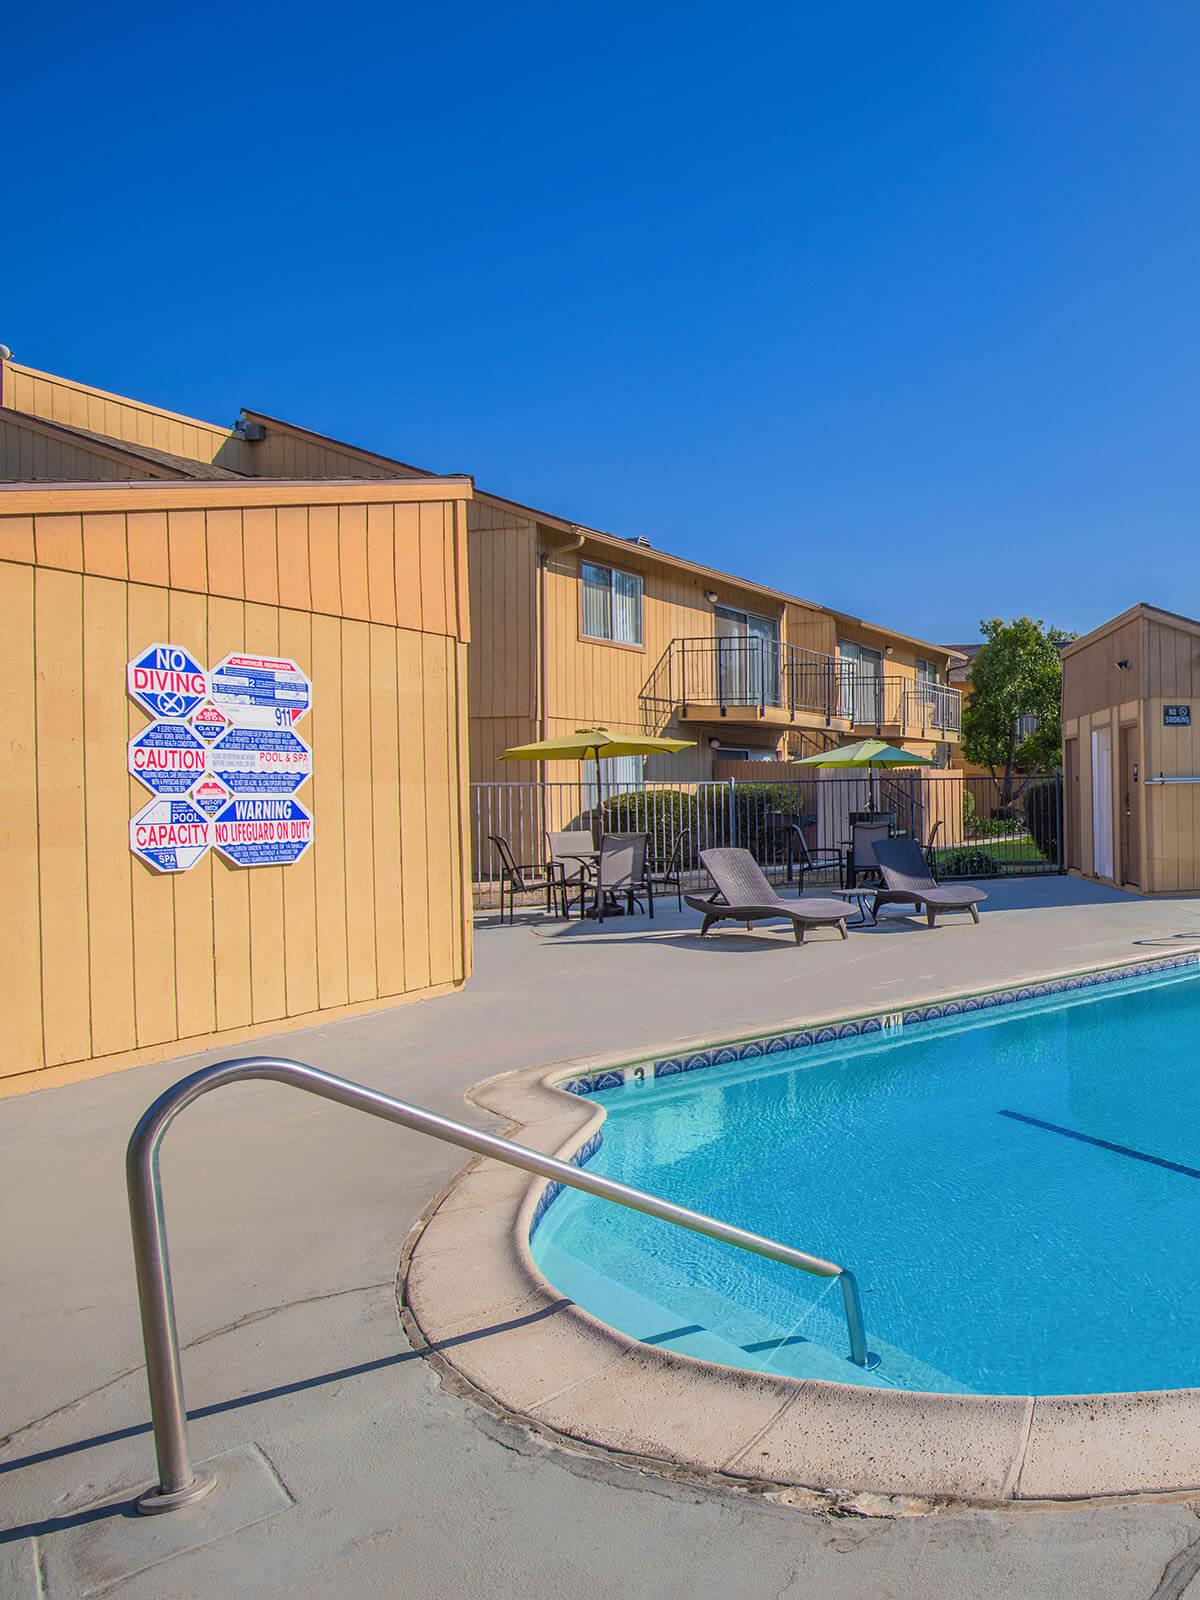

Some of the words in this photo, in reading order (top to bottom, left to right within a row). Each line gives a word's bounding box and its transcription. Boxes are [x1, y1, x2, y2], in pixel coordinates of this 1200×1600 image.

[156, 648, 186, 671] NO
[134, 669, 206, 694] DIVING
[249, 679, 255, 687] 2
[274, 708, 292, 727] 911
[134, 749, 205, 769] CAUTION
[259, 752, 283, 762] POOL
[285, 753, 291, 762] &
[292, 753, 308, 763] SPA
[173, 813, 200, 823] POOL
[235, 800, 292, 820] WARNING
[136, 823, 209, 847] CAPACITY
[215, 827, 228, 843] NO
[230, 824, 275, 843] LIFEGUARD
[277, 823, 289, 839] ON
[291, 821, 311, 839] DUTY
[158, 854, 176, 863] SPA
[634, 1066, 645, 1080] 3
